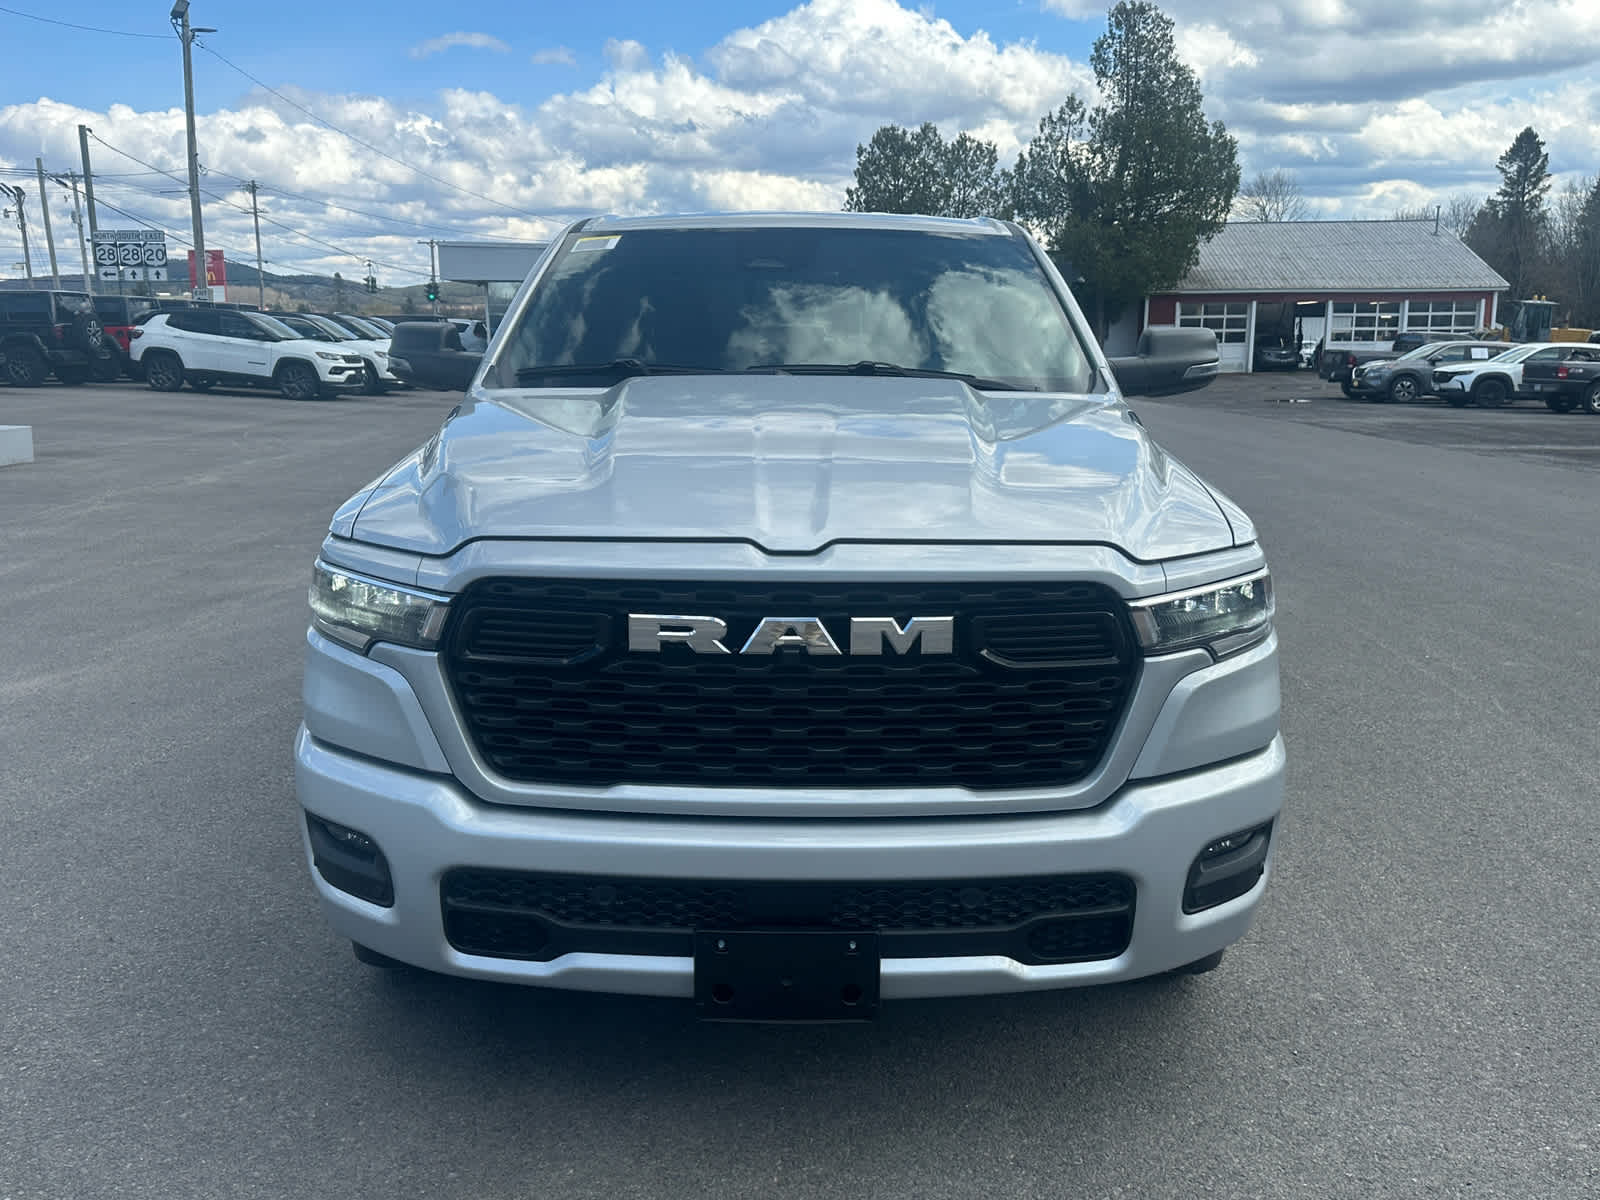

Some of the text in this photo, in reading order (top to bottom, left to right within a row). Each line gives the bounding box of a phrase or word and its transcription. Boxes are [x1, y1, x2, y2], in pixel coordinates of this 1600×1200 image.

[94, 232, 115, 240] NORTH
[118, 232, 140, 240] SOUTH
[145, 232, 162, 240] EAST
[97, 248, 116, 261] 28
[122, 248, 140, 261] 28
[146, 248, 165, 261] 20
[628, 613, 955, 655] RAM
